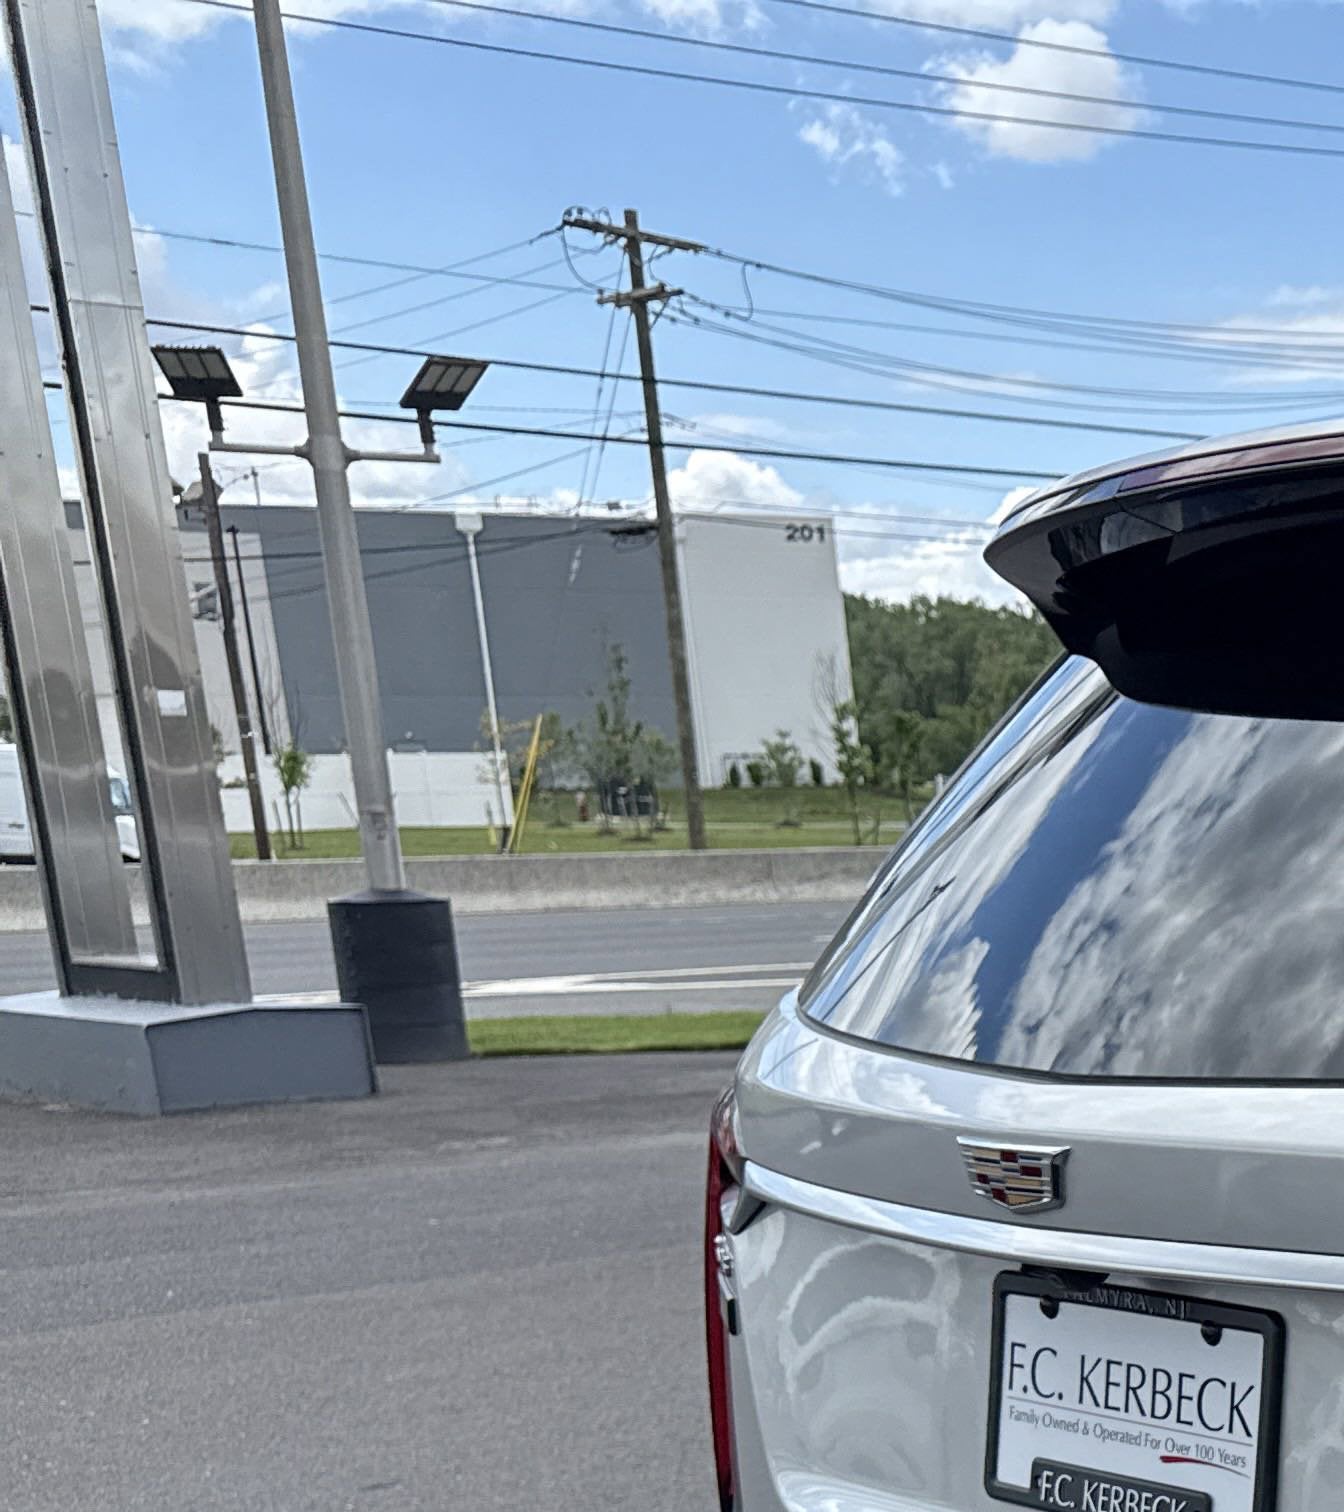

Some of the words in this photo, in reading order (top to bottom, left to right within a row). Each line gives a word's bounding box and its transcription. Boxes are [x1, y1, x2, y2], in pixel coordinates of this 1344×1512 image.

[786, 523, 826, 542] 201
[1008, 1342, 1064, 1401] F.C.
[1078, 1354, 1255, 1438] KERBECK
[1009, 1405, 1040, 1428] Family
[1042, 1412, 1080, 1433] Owned
[1082, 1421, 1090, 1436] &
[1093, 1423, 1142, 1446] Operated
[1144, 1432, 1161, 1450] For
[1164, 1437, 1191, 1456] Over
[1195, 1444, 1215, 1461] 100
[1217, 1448, 1247, 1469] Years
[1040, 1470, 1075, 1508] F.C.
